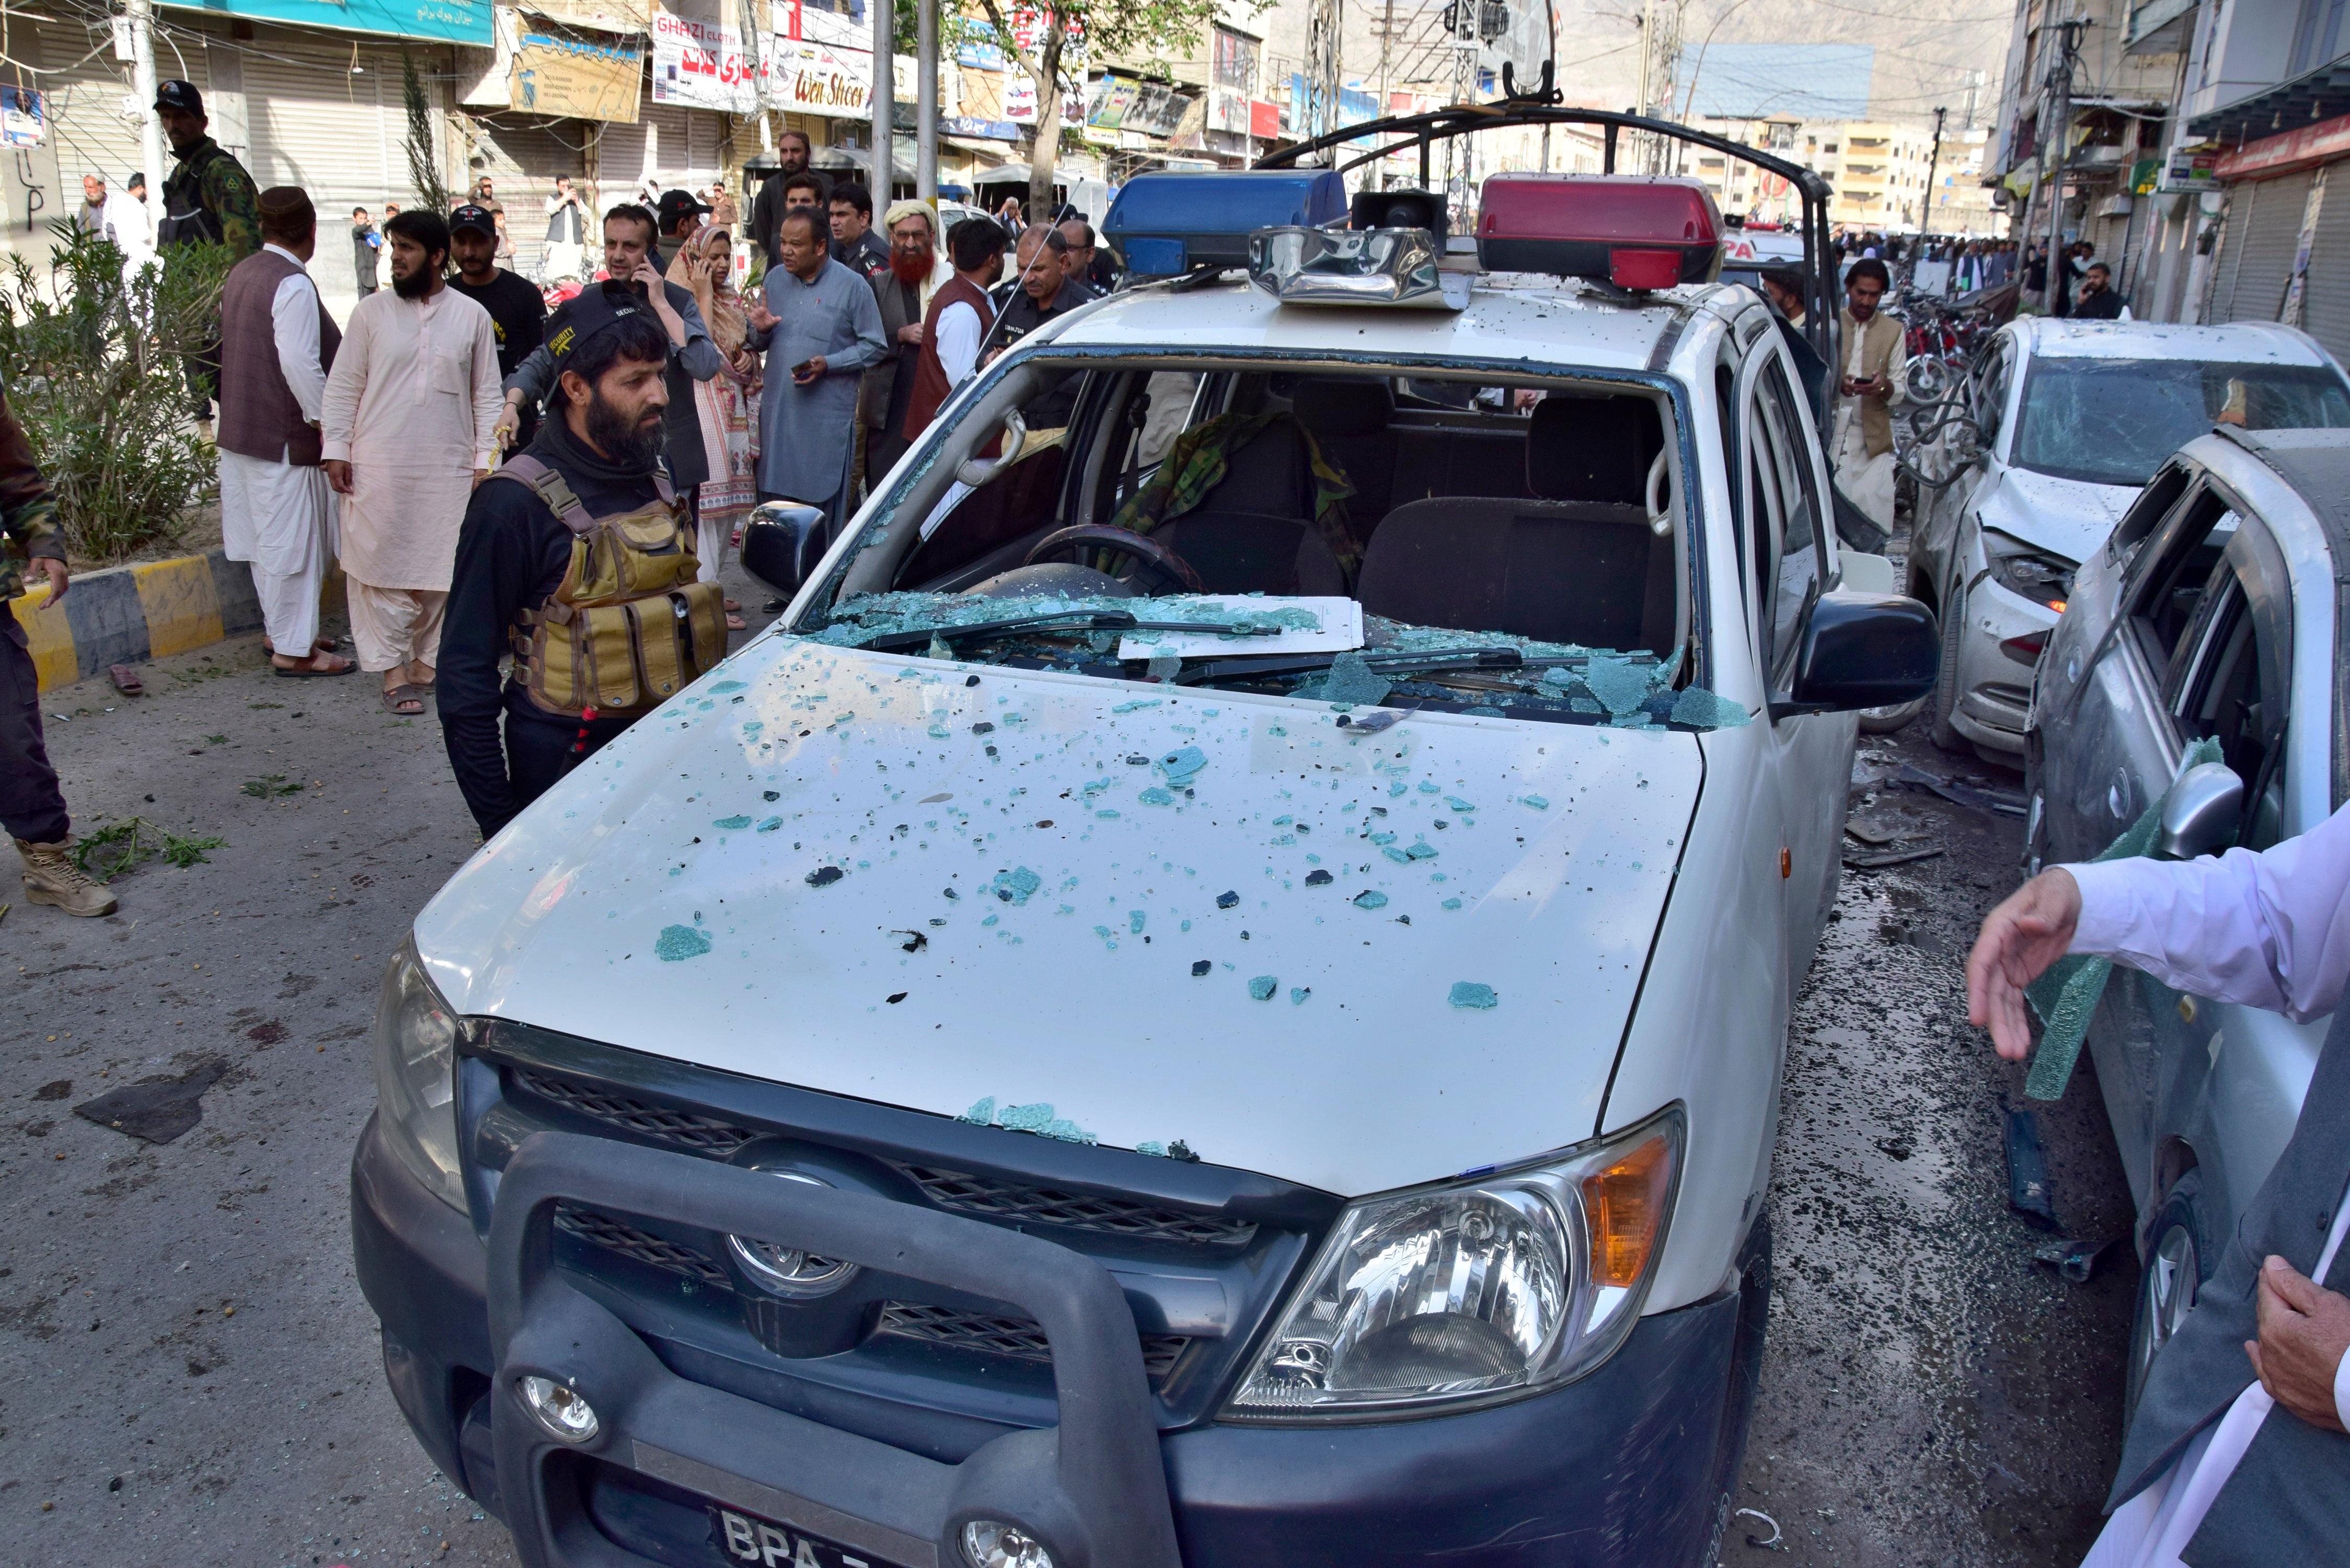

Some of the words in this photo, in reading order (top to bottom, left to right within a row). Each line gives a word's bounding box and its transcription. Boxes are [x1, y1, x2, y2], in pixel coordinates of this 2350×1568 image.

[658, 17, 704, 40] GHAZI
[707, 31, 735, 44] CLOTH
[820, 52, 834, 64] Bata
[827, 72, 863, 108] Shoes
[2136, 184, 2156, 194] AT
[549, 326, 574, 351] SECURITY
